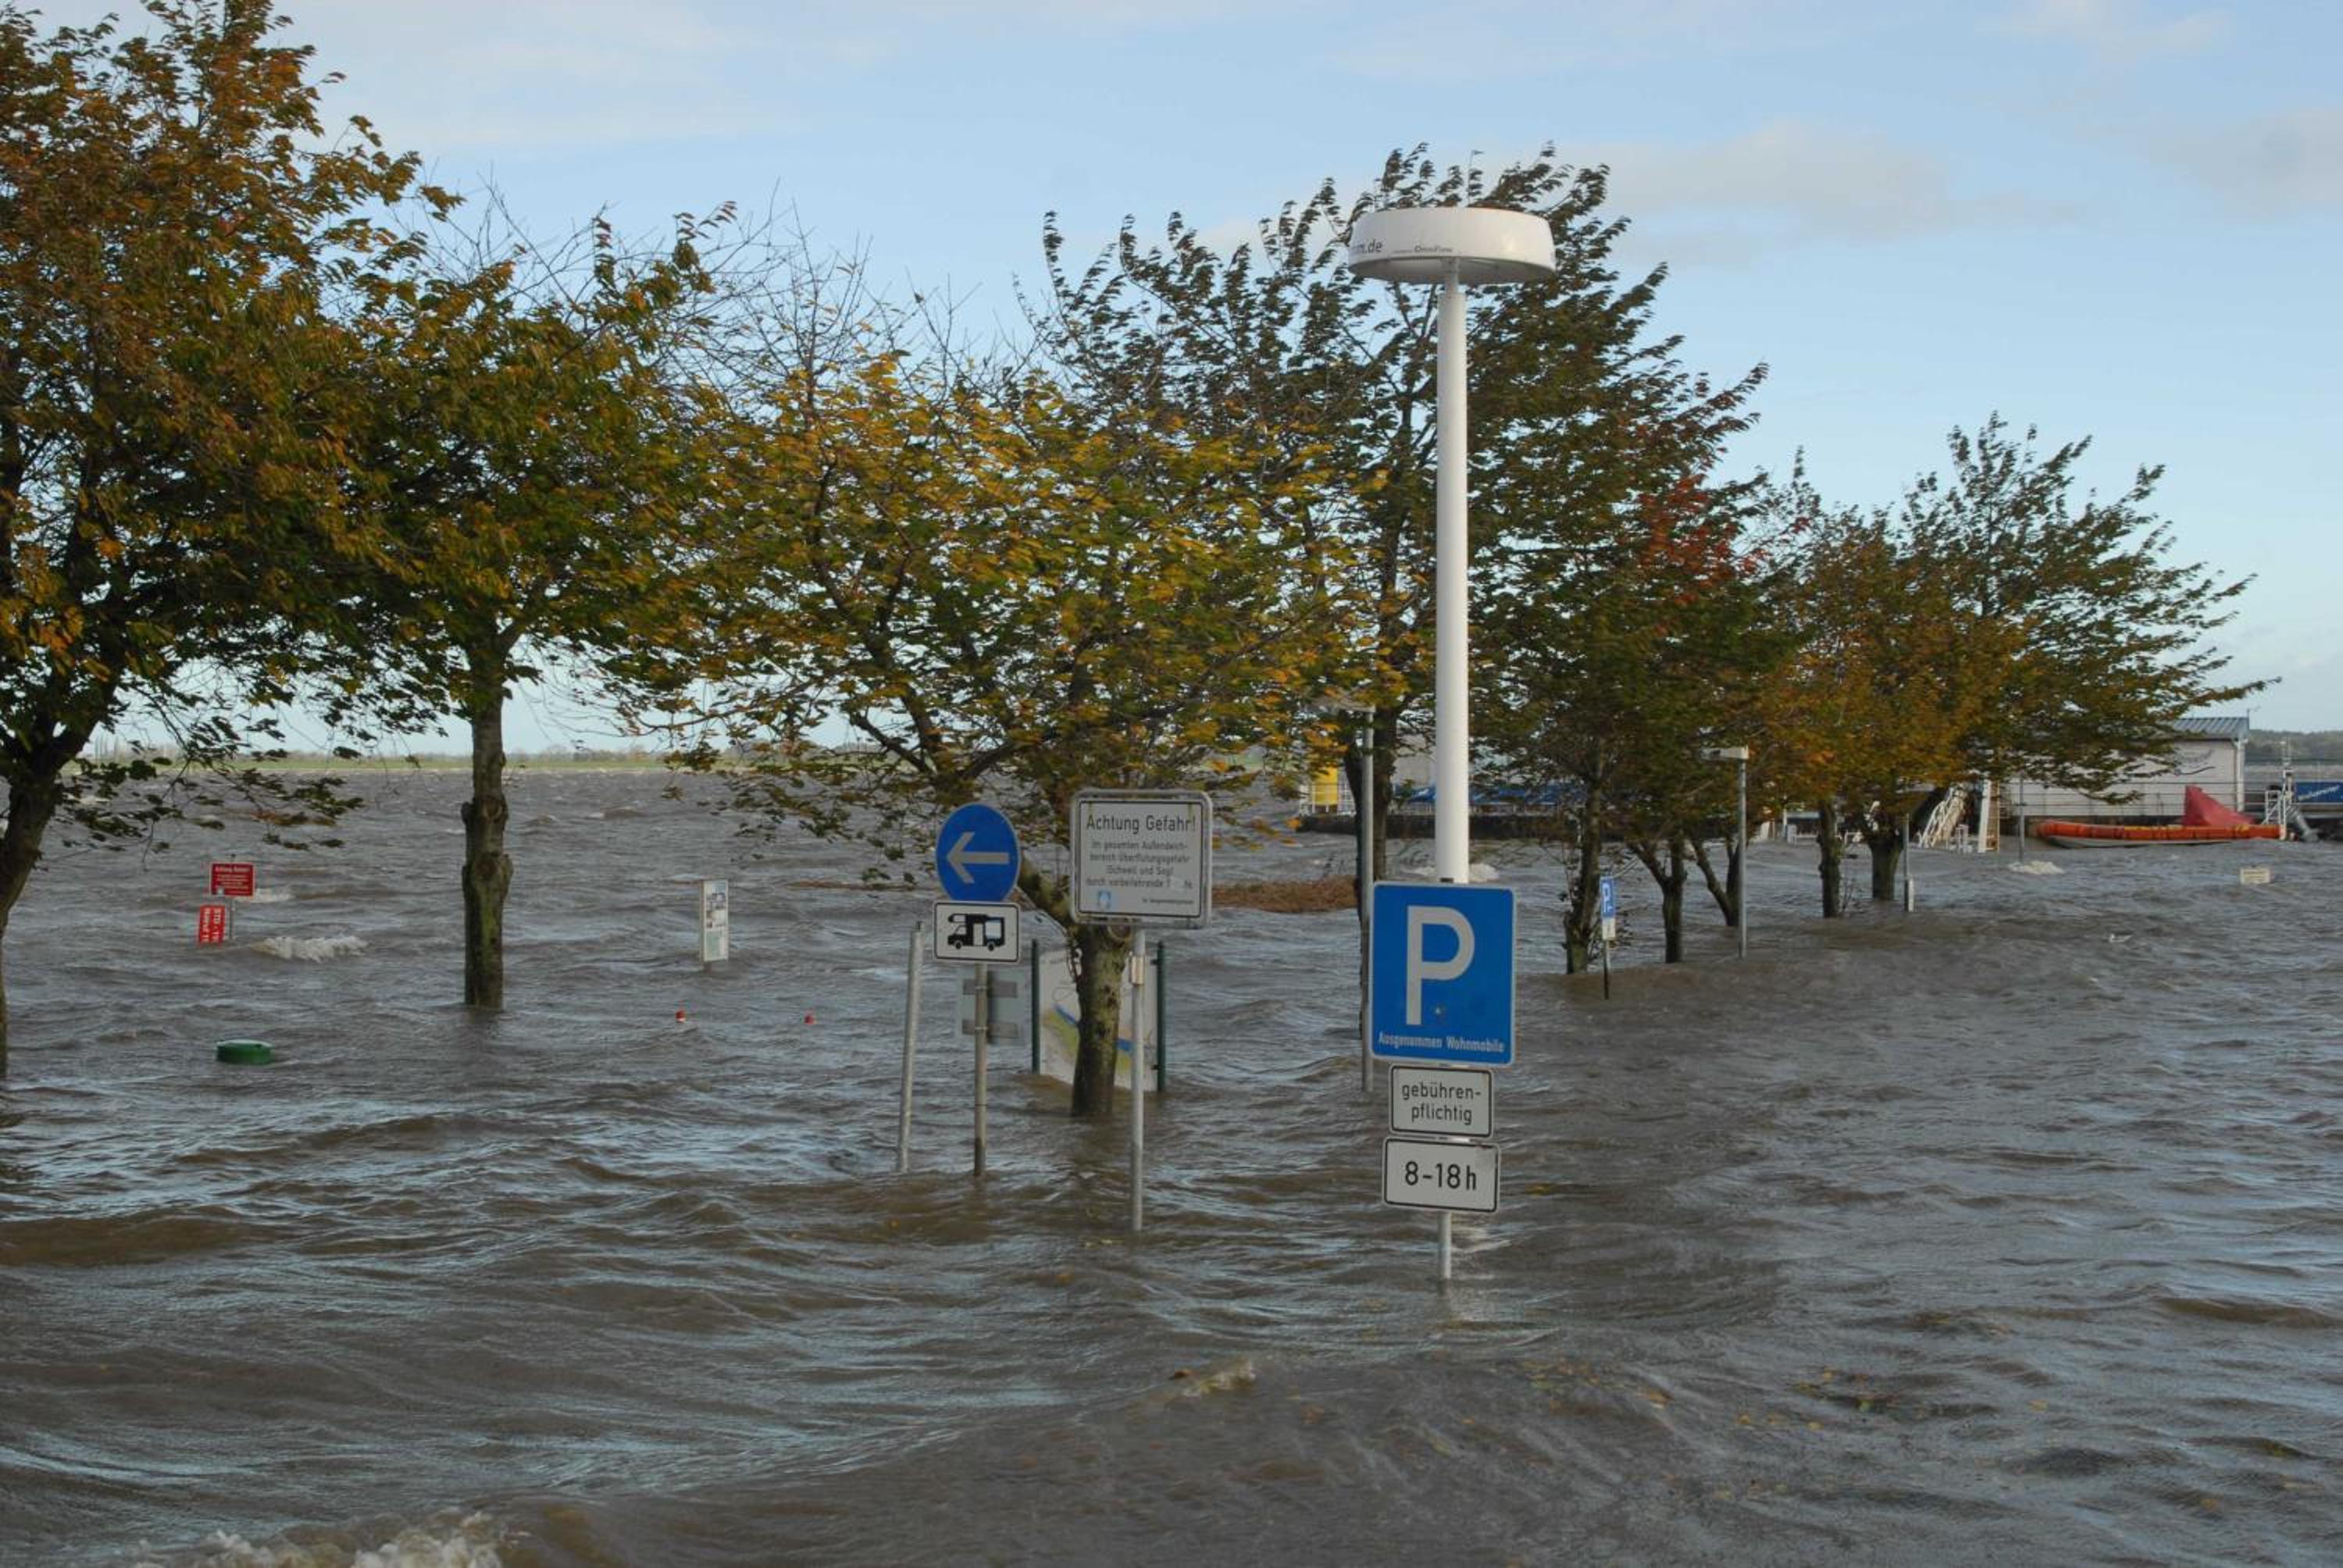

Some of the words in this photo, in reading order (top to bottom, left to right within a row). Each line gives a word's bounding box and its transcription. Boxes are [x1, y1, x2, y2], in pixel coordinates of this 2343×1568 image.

[1086, 814, 1139, 835] Achtung
[1145, 814, 1196, 832] Gefahr!
[1406, 905, 1475, 1025] P
[1378, 1031, 1443, 1049] Ausgenommen
[1446, 1035, 1504, 1053] Wohnmobile
[1402, 1081, 1482, 1101] gebühren-
[1411, 1103, 1472, 1125] pflichtig
